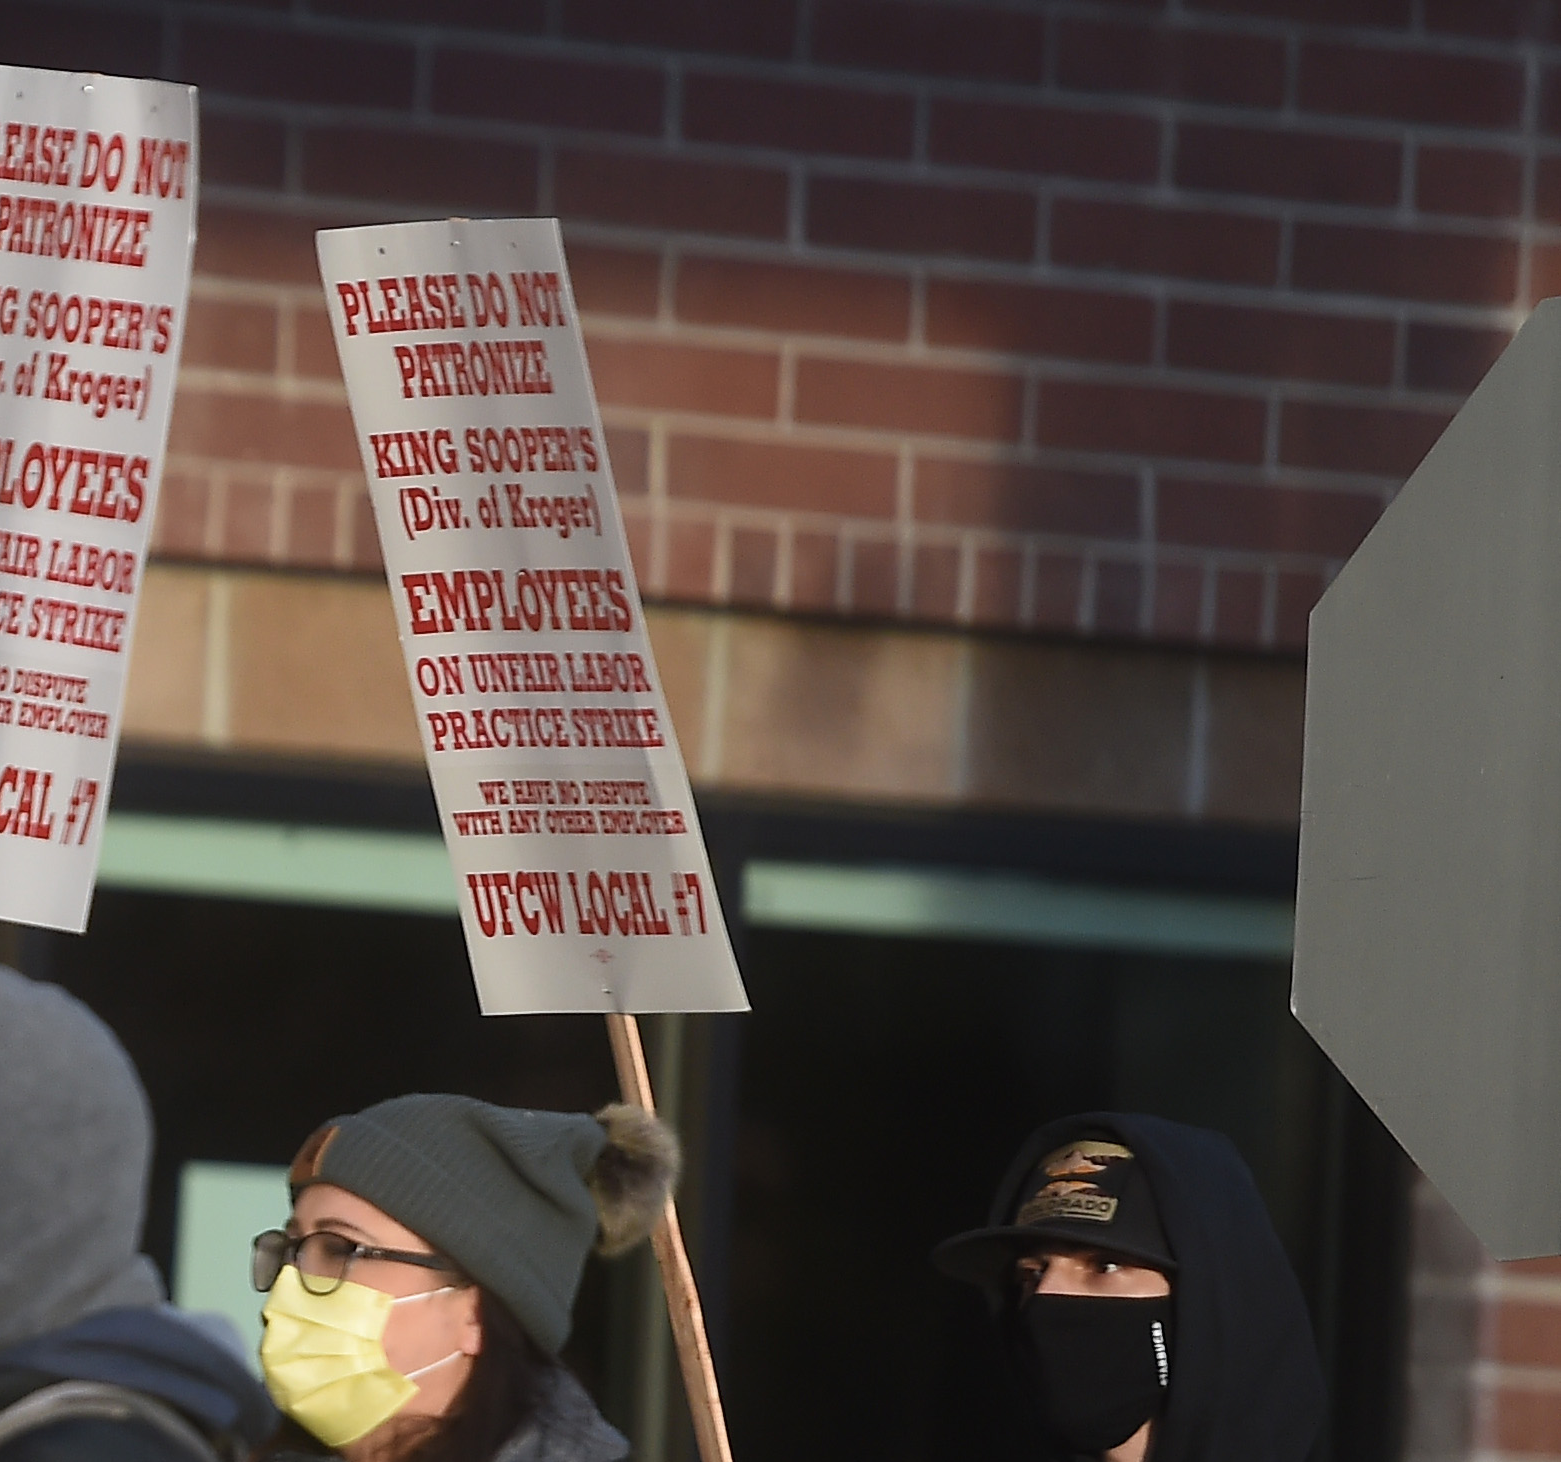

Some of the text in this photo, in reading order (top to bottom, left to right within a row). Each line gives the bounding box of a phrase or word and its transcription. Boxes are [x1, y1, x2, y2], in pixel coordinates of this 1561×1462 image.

[80, 133, 126, 192] DO
[133, 139, 189, 200] NOT
[25, 291, 174, 354] SOOPER'S
[337, 272, 566, 336] PLEASE DO NOT
[14, 352, 40, 397] of
[43, 354, 150, 419] Kroger)
[394, 341, 553, 399] PATRONIZE
[370, 427, 599, 478] KING SOOPER'S
[399, 483, 601, 540] (Div. of Kroger)
[45, 540, 136, 594] LABOR
[28, 598, 126, 653] STRIKE
[401, 570, 632, 635] EMPLOYEES
[416, 653, 653, 697] ON UNFAIR LABOR
[427, 708, 665, 752] PRACTICE STRIKE
[60, 778, 100, 846] #7
[467, 871, 708, 938] UFCW LOCAL #7
